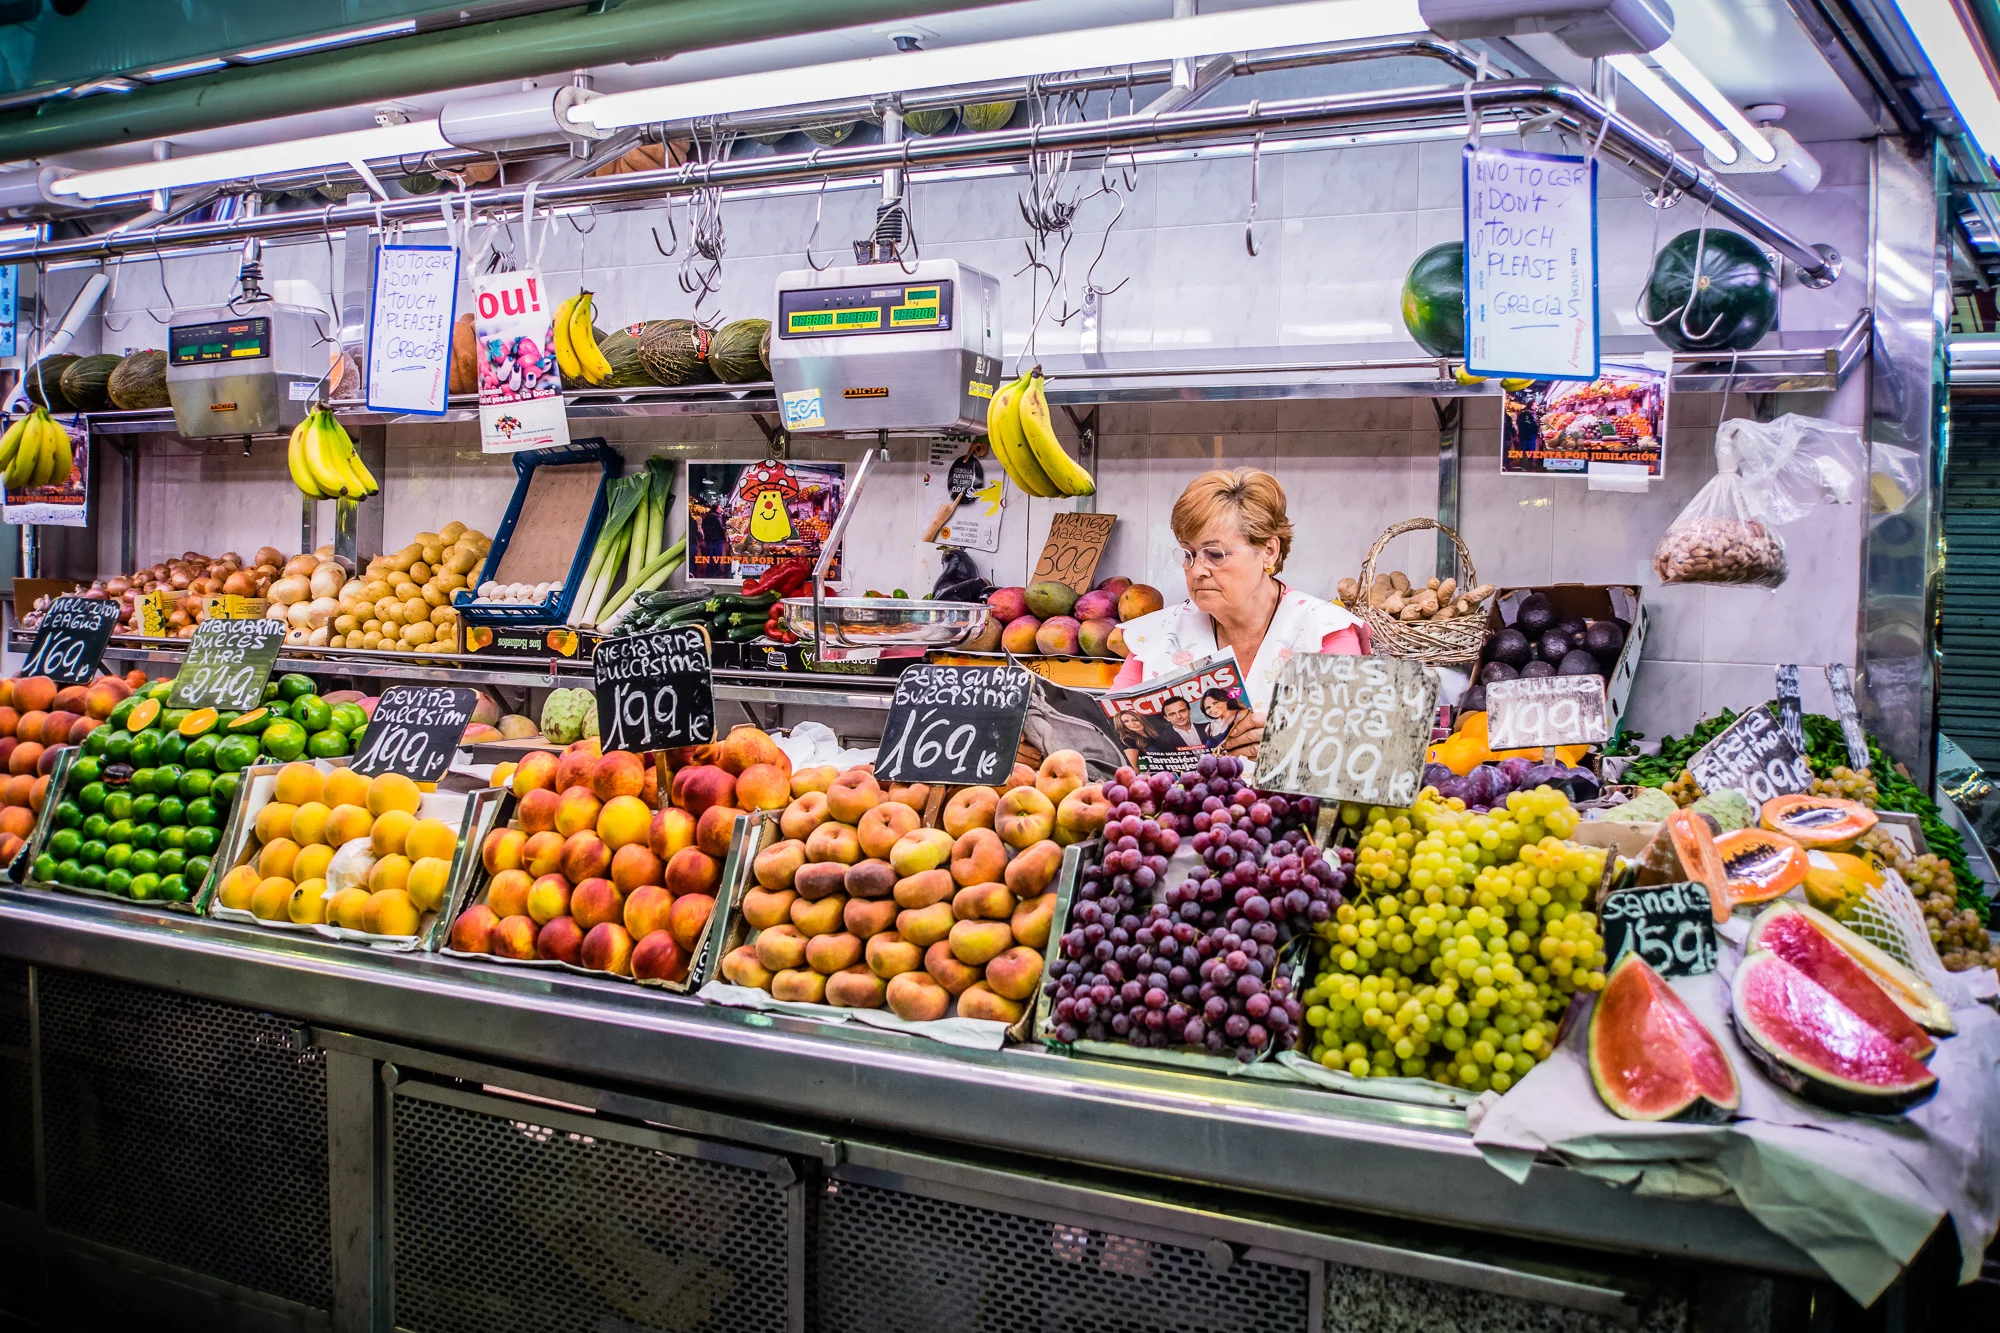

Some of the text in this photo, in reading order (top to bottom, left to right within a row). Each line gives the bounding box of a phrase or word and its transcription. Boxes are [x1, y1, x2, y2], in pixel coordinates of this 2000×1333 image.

[1483, 161, 1509, 182] NO
[1484, 216, 1554, 248] TOUCH
[1487, 250, 1557, 281] PLEASE
[390, 272, 434, 287] DON'T
[1571, 268, 1579, 300] STADA
[388, 292, 438, 309] TOUCH
[387, 313, 436, 331] PLEASE
[843, 387, 888, 396] micra
[1508, 450, 1658, 462] EN VENTA POR JUBILACIÓN
[694, 556, 710, 564] EN
[712, 556, 748, 565] VENTA
[752, 556, 774, 565] POR
[1101, 667, 1235, 717] LECTURAS
